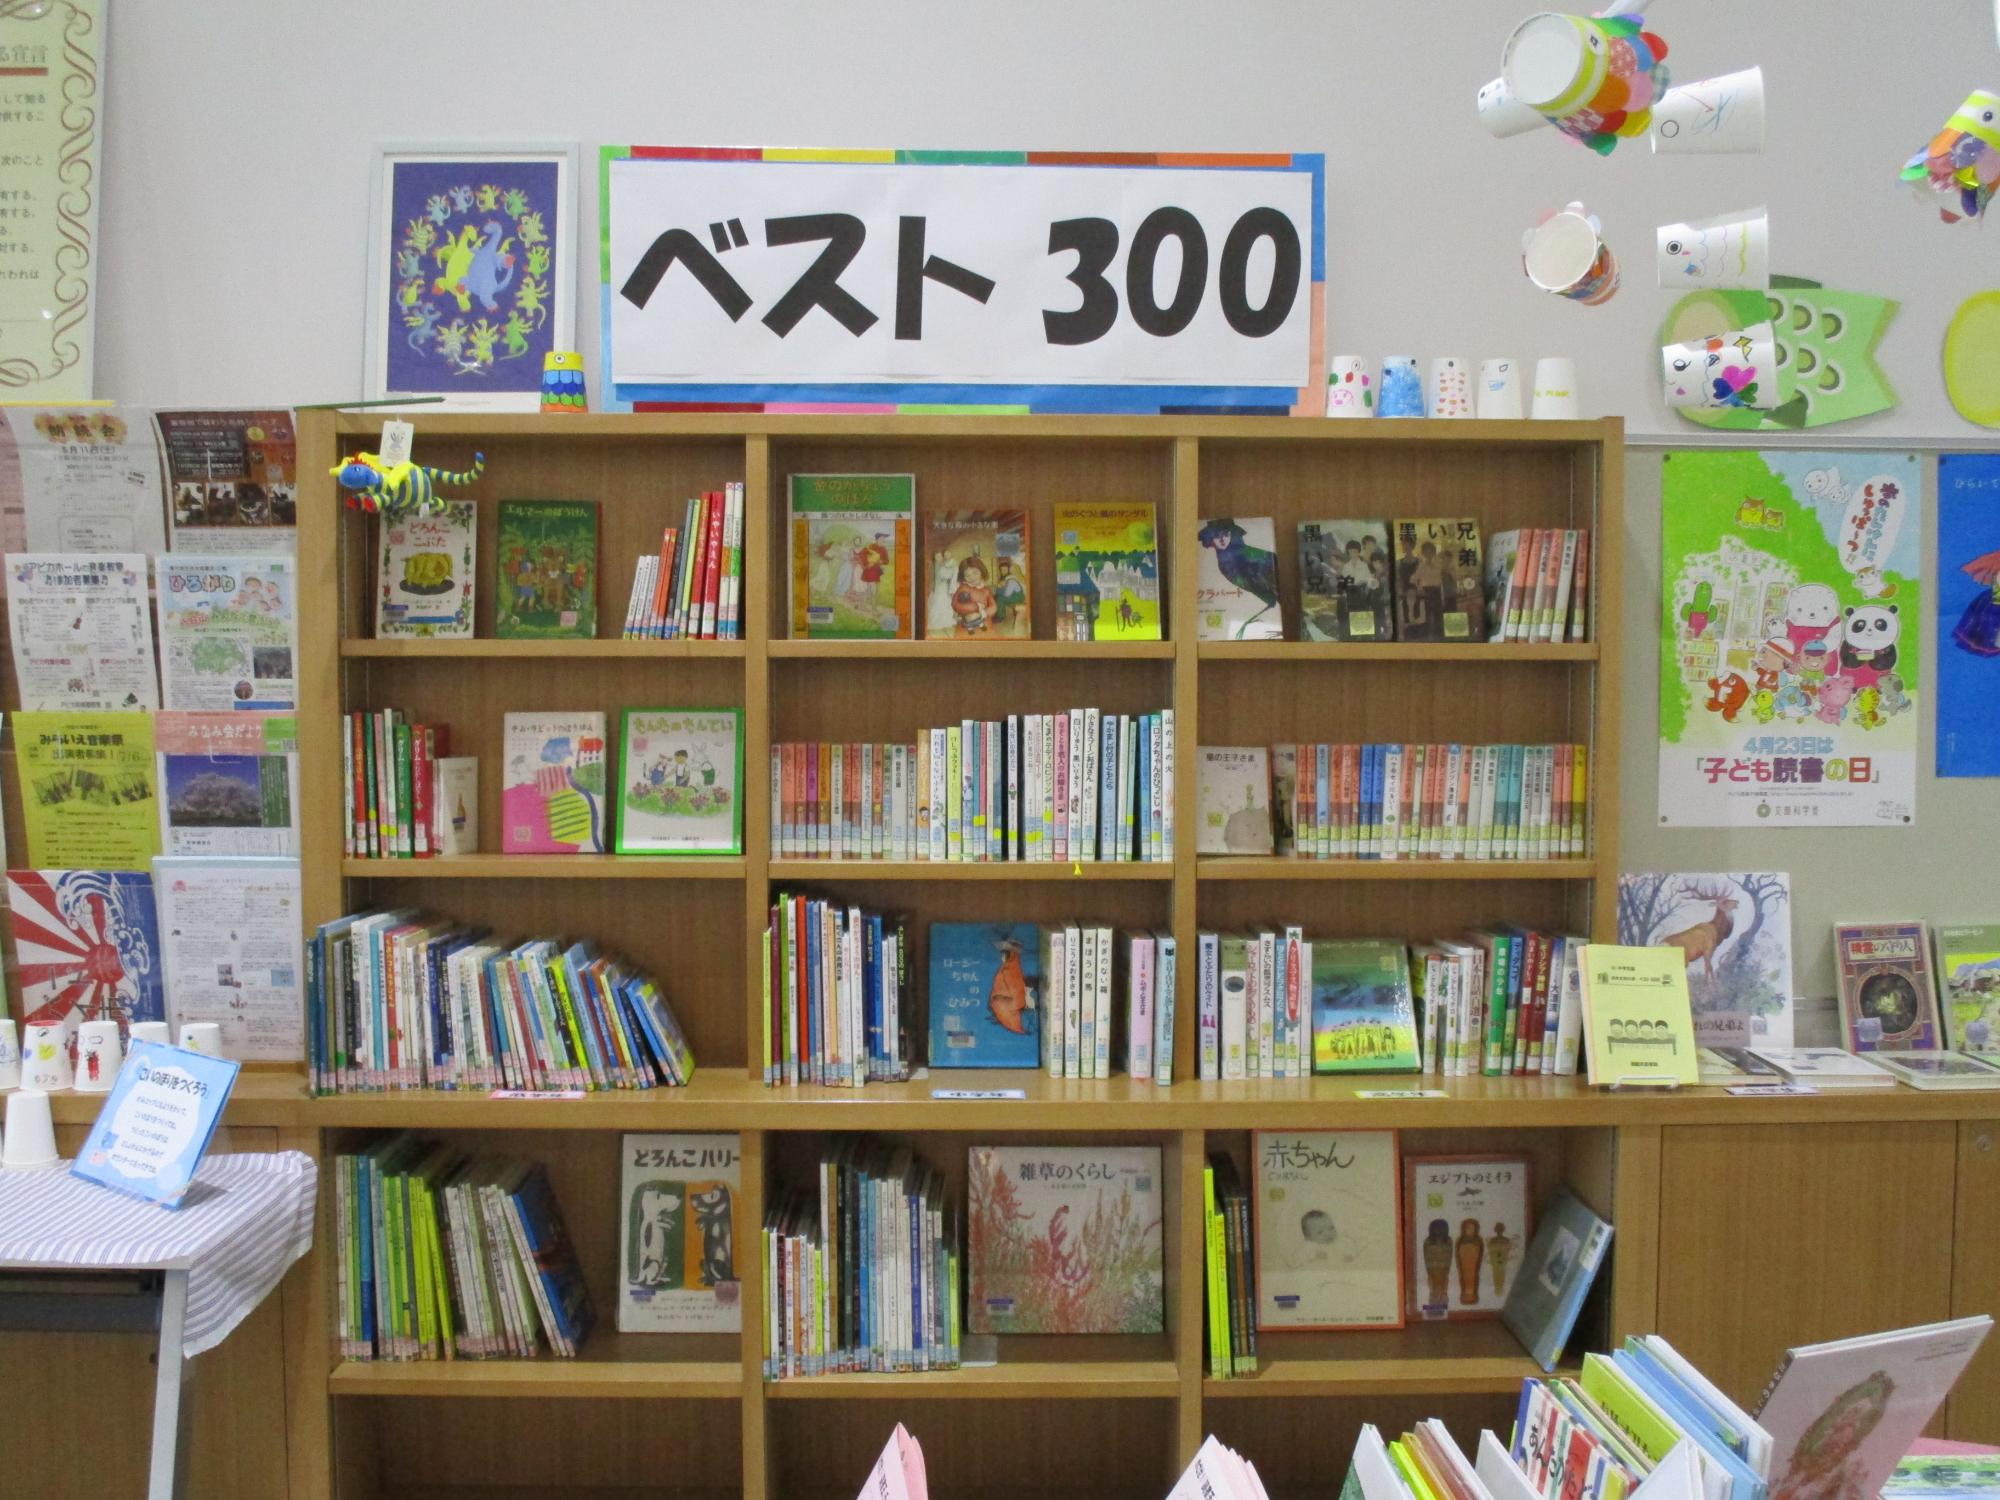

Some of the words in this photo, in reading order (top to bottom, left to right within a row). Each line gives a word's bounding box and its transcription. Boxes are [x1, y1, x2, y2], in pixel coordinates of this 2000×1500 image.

[620, 213, 997, 341] ベスト
[1041, 206, 1302, 346] 300
[709, 510, 720, 569] いやいやえん
[168, 574, 236, 593] ひろがり
[1164, 716, 1175, 774] 山の上の火
[1206, 752, 1255, 763] 星の王子さま
[1743, 736, 1834, 755] 4月23日は
[1696, 756, 1881, 784] 「子ども読書の日」
[1084, 936, 1093, 993] まほうの馬
[1099, 938, 1108, 994] かぎのない箱
[633, 1149, 741, 1168] どろんこハリー
[1263, 1139, 1355, 1170] 赤ちゃん
[1019, 1162, 1117, 1182] 雑草のくらし
[1428, 1171, 1513, 1185] エジプトのミイラ
